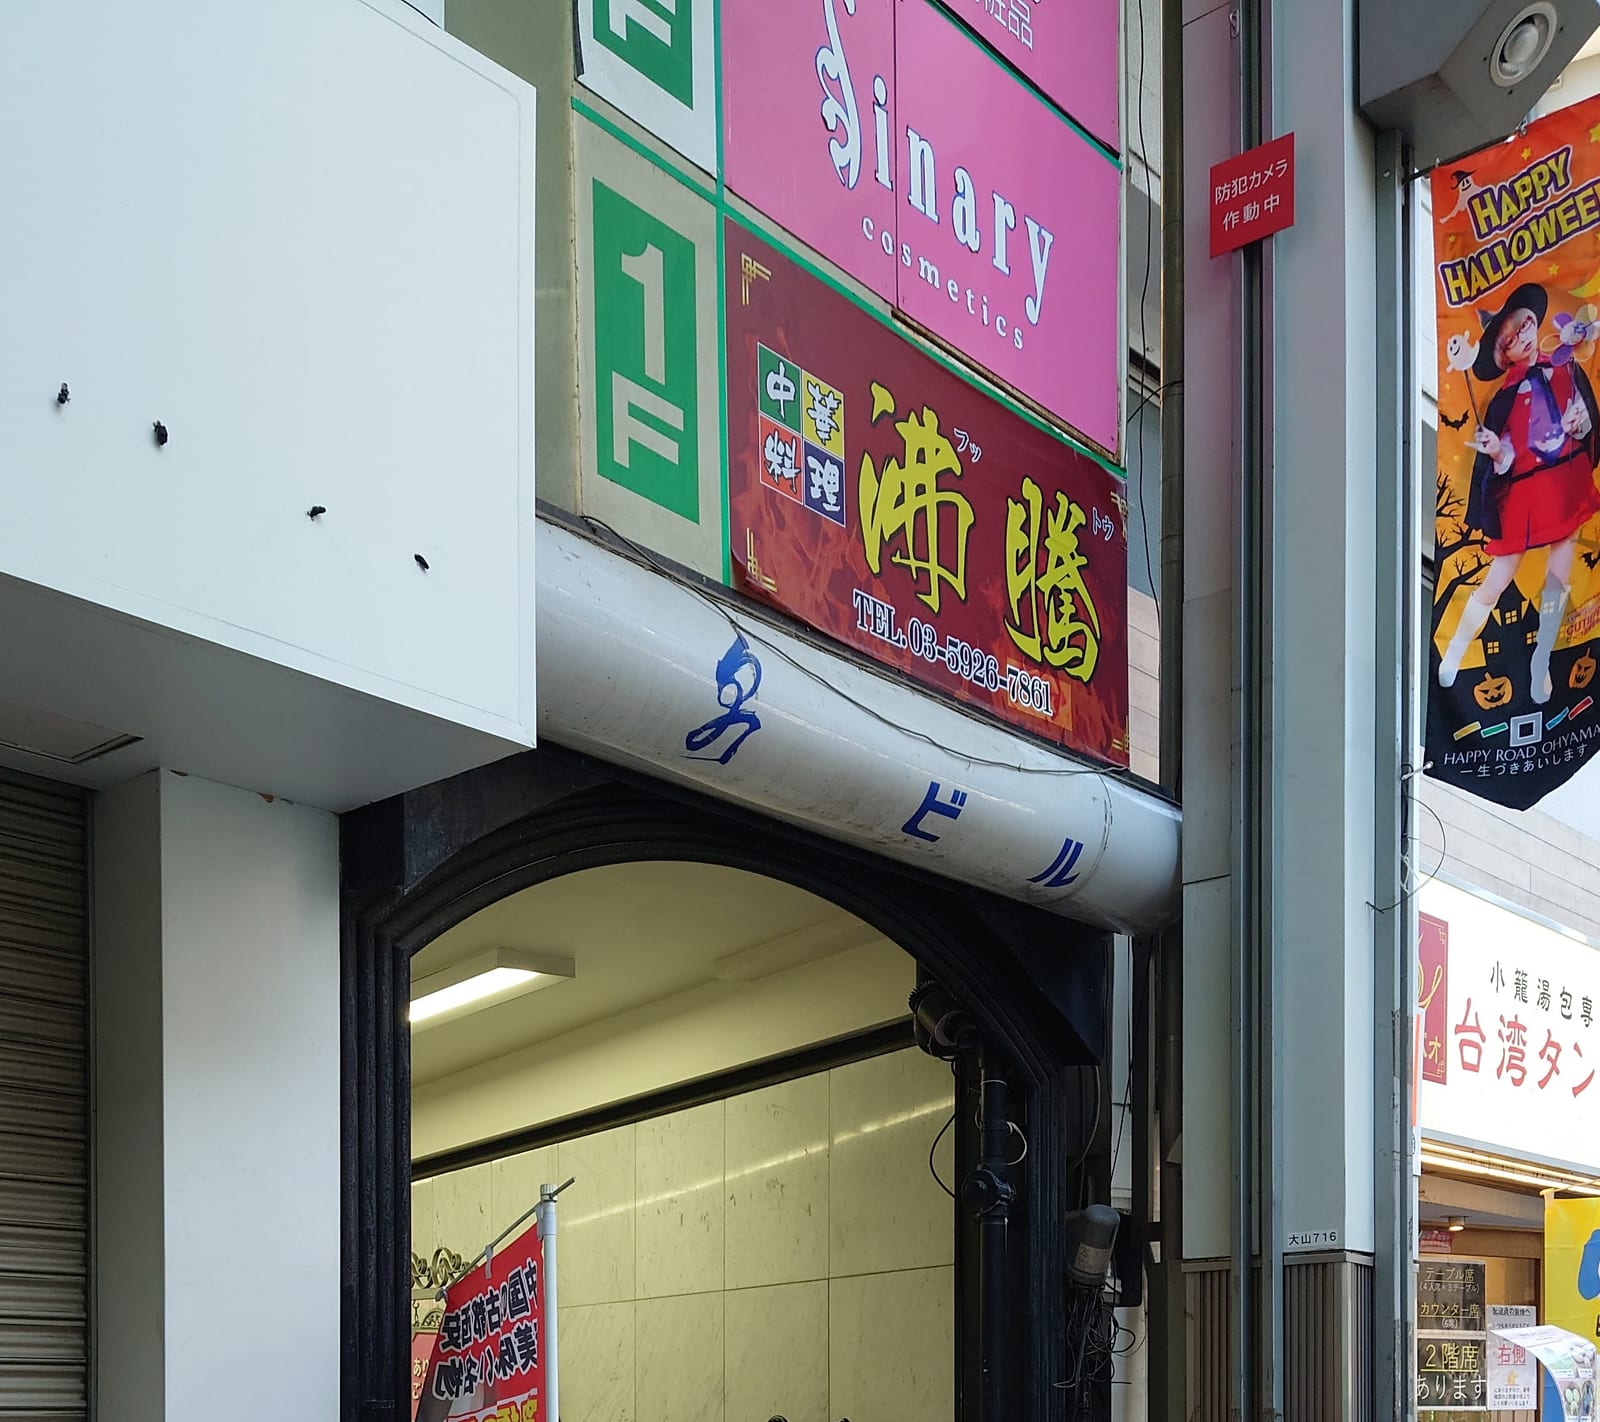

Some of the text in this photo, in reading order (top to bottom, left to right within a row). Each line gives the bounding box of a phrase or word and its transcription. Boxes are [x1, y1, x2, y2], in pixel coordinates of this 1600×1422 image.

[1214, 158, 1288, 206] 防犯カメラ
[1469, 149, 1570, 238] HAPPY
[1222, 193, 1280, 232] 作動中
[862, 216, 1024, 350] cosmetics
[613, 243, 685, 468] 1F
[1443, 723, 1600, 766] HAPPY ROAD OHYAMA
[1459, 743, 1588, 778] 一生づきあいします
[1455, 997, 1595, 1098] 台湾タン
[1288, 1231, 1337, 1246] 大山716
[1420, 1302, 1480, 1318] カウンター席
[1497, 1343, 1526, 1364] 右側
[1416, 1374, 1487, 1400] あります
